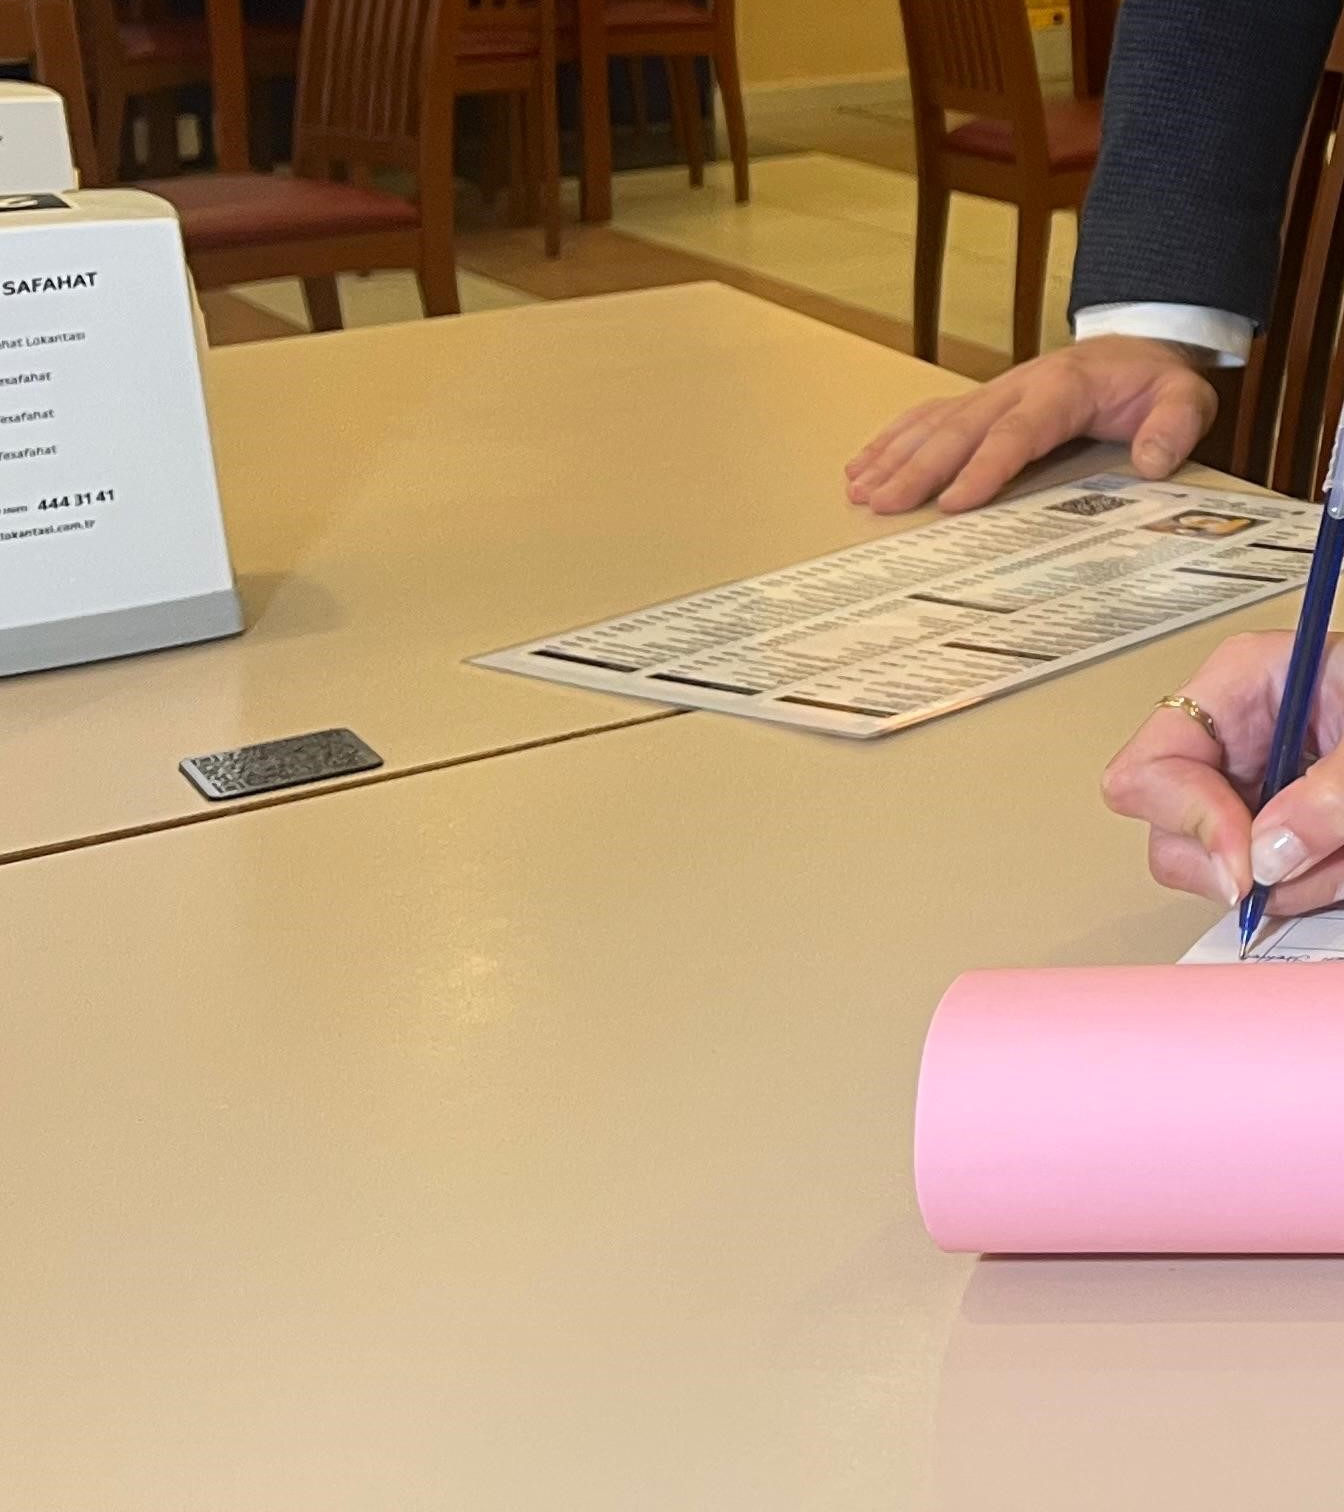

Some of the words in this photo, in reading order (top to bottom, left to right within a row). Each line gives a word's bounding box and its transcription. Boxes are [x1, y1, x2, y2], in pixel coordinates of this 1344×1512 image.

[2, 271, 98, 296] SAFAHAT
[38, 496, 70, 511] 444
[74, 492, 91, 507] 31
[96, 489, 114, 502] 41
